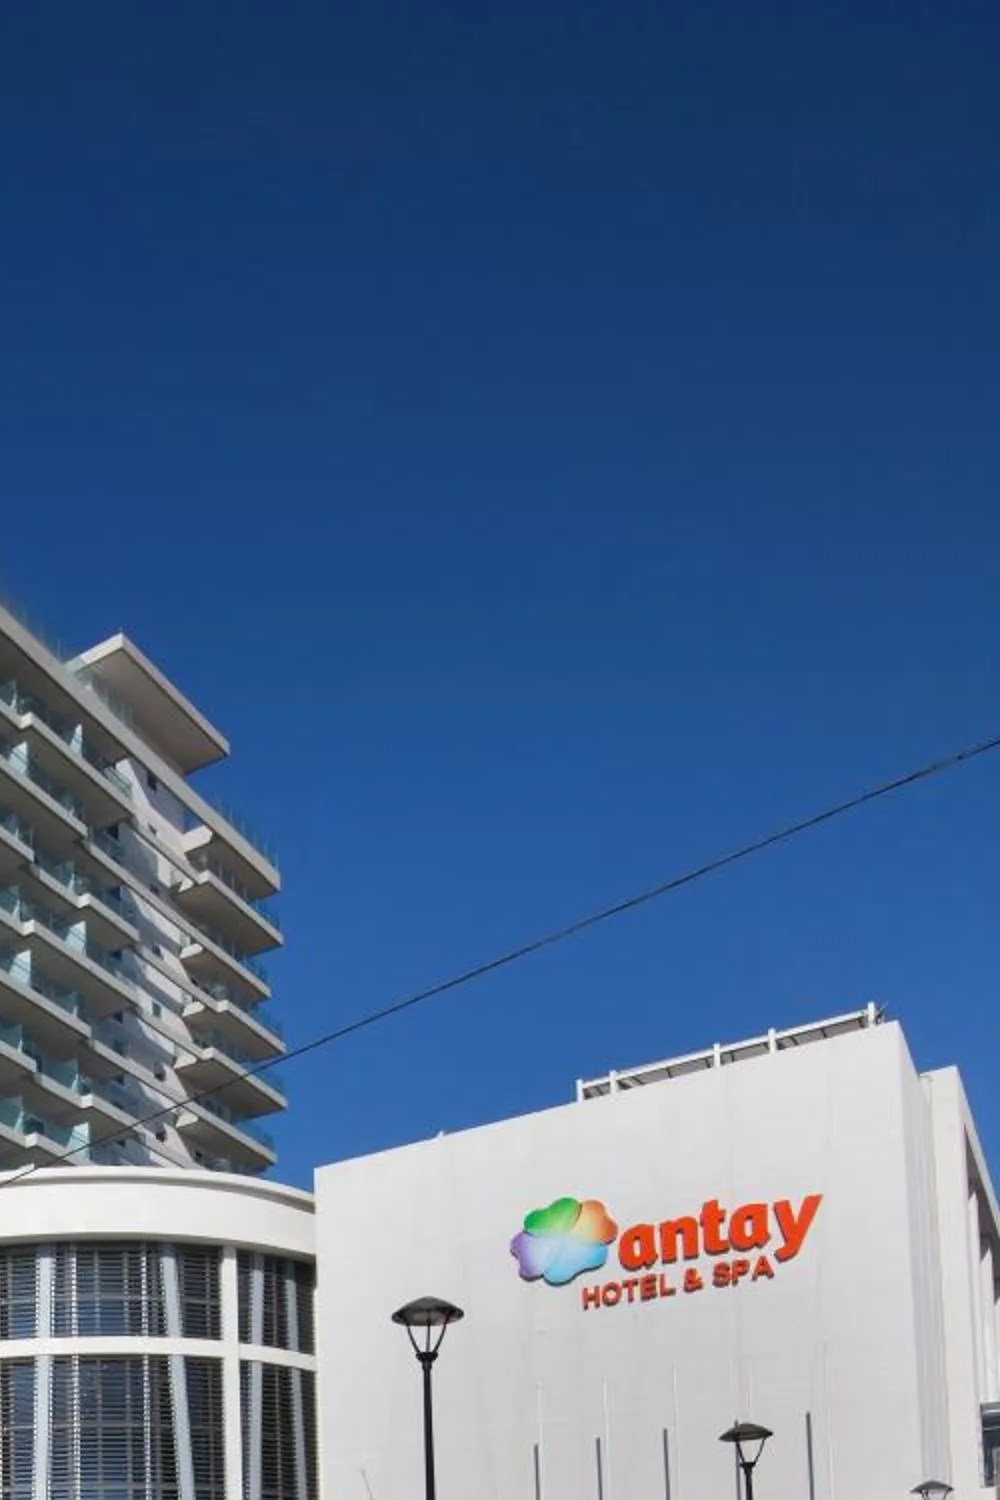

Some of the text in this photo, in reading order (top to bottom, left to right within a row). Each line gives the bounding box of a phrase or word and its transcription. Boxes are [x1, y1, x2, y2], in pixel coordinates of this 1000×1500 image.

[618, 1193, 823, 1271] antay
[582, 1255, 775, 1311] HOTEL & SPA
